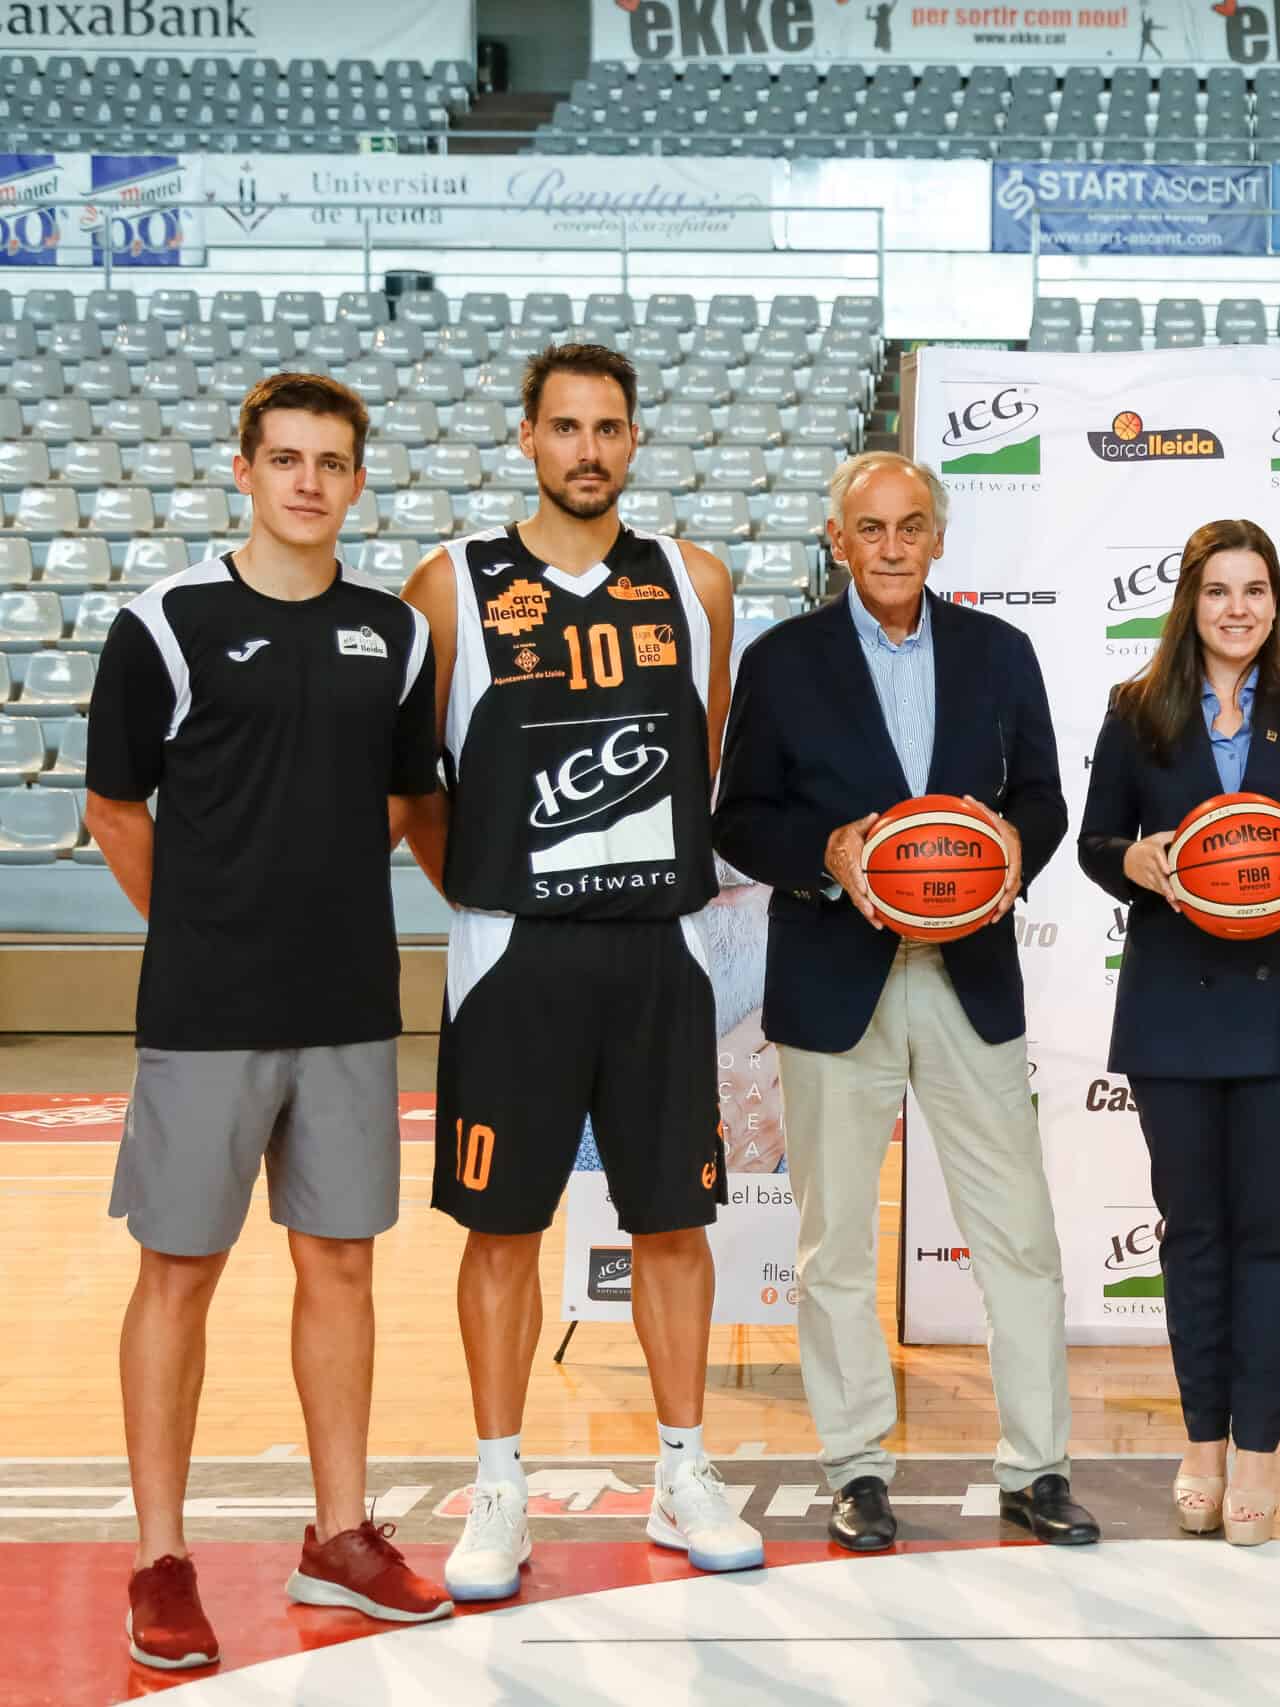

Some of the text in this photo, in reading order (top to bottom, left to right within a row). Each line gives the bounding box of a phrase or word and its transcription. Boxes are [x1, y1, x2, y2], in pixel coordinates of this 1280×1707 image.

[0, 0, 256, 37] aixaBank
[911, 6, 1127, 28] per sortir com nou!
[629, 0, 814, 61] ekke
[312, 171, 468, 194] Universitat
[1038, 173, 1262, 203] START ASCENT
[948, 388, 1024, 440] ICG
[941, 478, 1041, 492] Software
[512, 594, 543, 605] ara
[490, 603, 538, 621] lleida
[563, 623, 624, 690] 10
[638, 643, 661, 653] LEB
[638, 653, 661, 663] ORO
[535, 724, 649, 817] ICG
[896, 836, 982, 861] molten
[535, 871, 677, 899] Software
[1238, 866, 1270, 883] FIBA
[923, 881, 956, 897] FIBA
[456, 1117, 496, 1192] 10
[732, 1185, 793, 1205] el bàs
[762, 1262, 798, 1282] fllei
[1103, 1302, 1164, 1315] Softw
